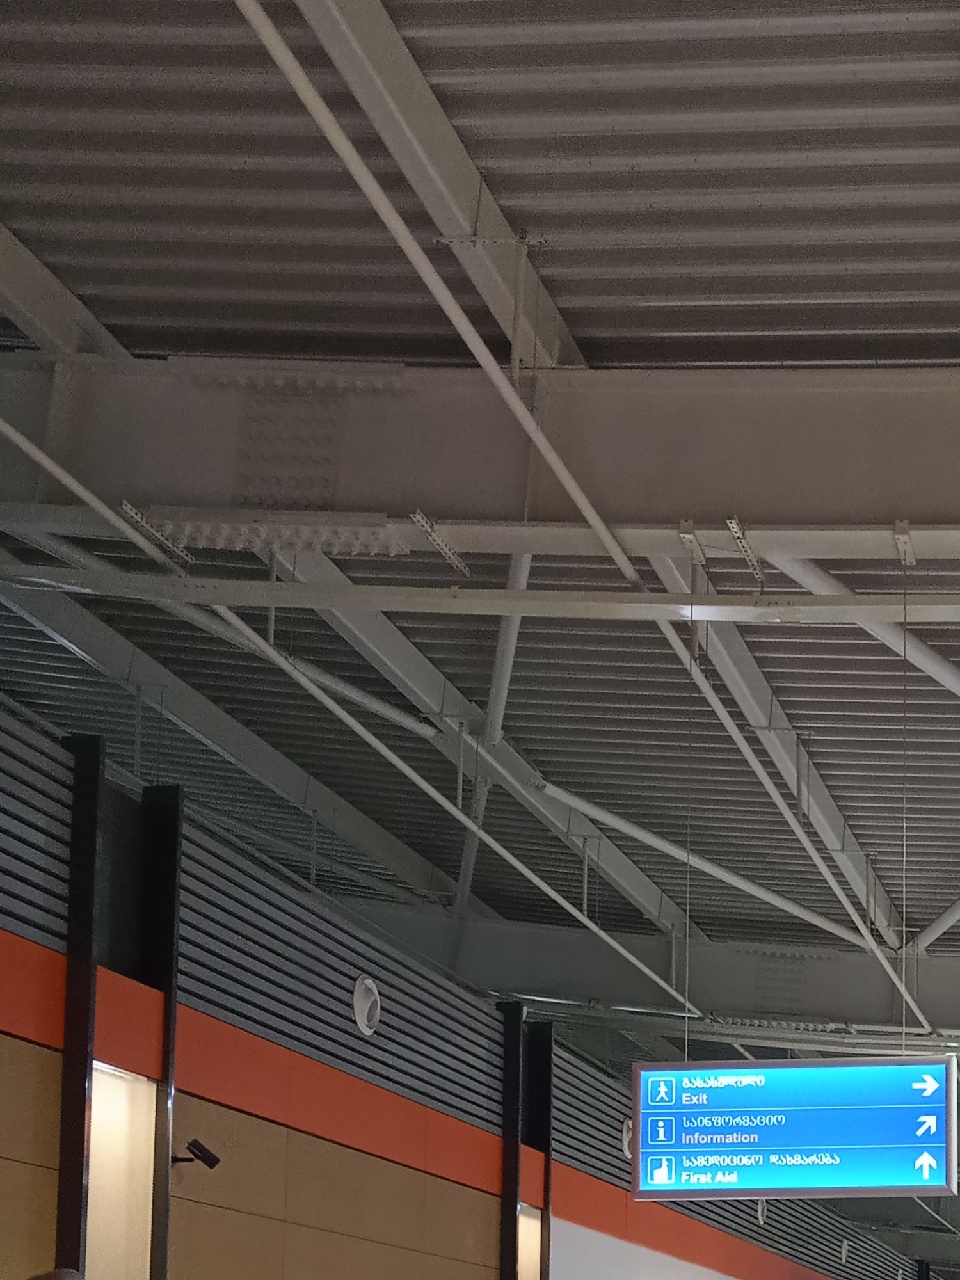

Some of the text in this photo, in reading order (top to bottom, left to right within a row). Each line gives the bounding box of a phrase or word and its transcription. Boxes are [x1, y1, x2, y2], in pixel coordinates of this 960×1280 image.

[682, 1093, 708, 1105] Exit
[683, 1115, 786, 1128] საინფორმაციო
[682, 1132, 759, 1144] Information
[681, 1171, 738, 1184] First Aid
